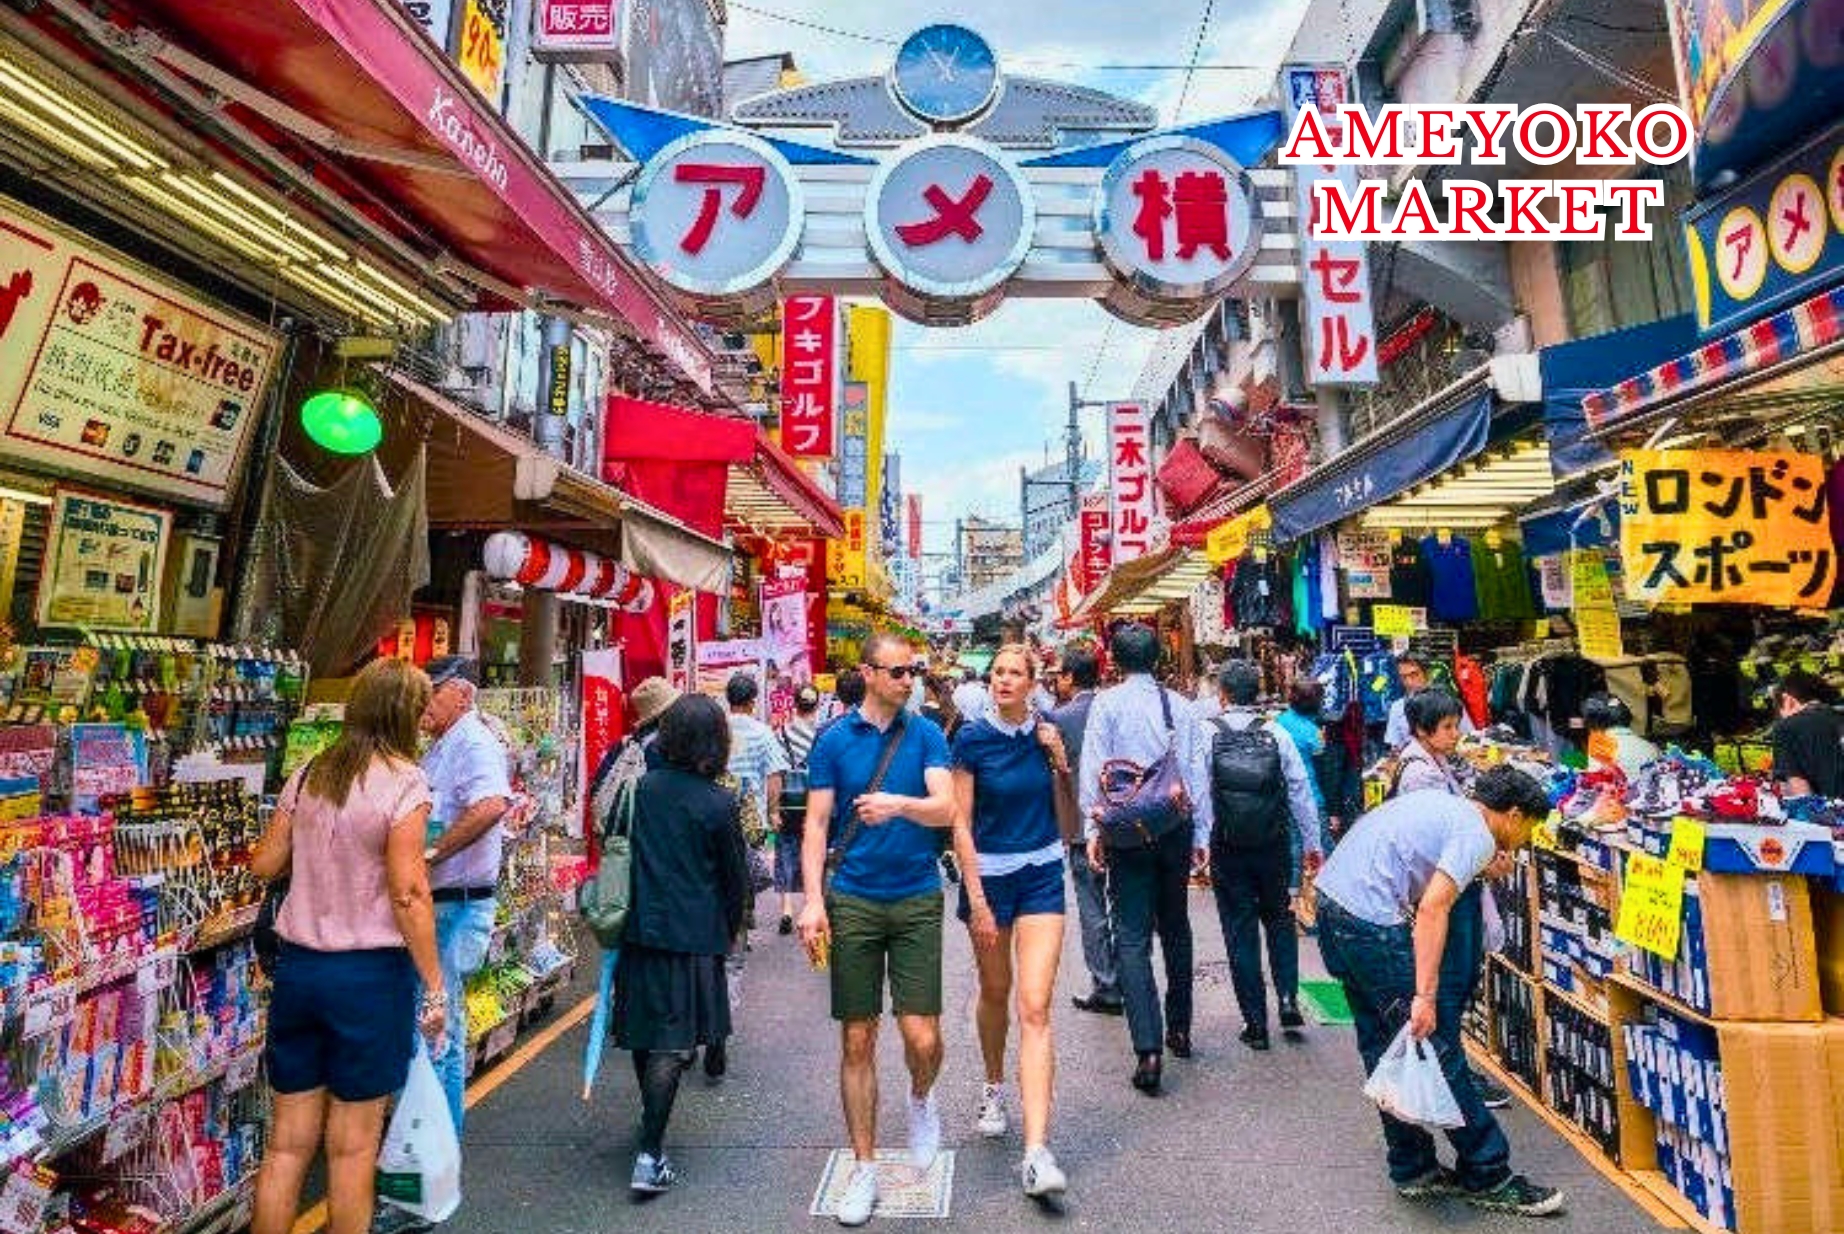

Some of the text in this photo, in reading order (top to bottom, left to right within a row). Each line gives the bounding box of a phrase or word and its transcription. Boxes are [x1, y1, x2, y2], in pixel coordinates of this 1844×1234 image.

[549, 3, 608, 31] 販売
[675, 163, 1232, 262] アメ横
[1621, 460, 1640, 516] NEW
[1645, 459, 1826, 523] ロンドン
[1642, 530, 1830, 597] スポーツ
